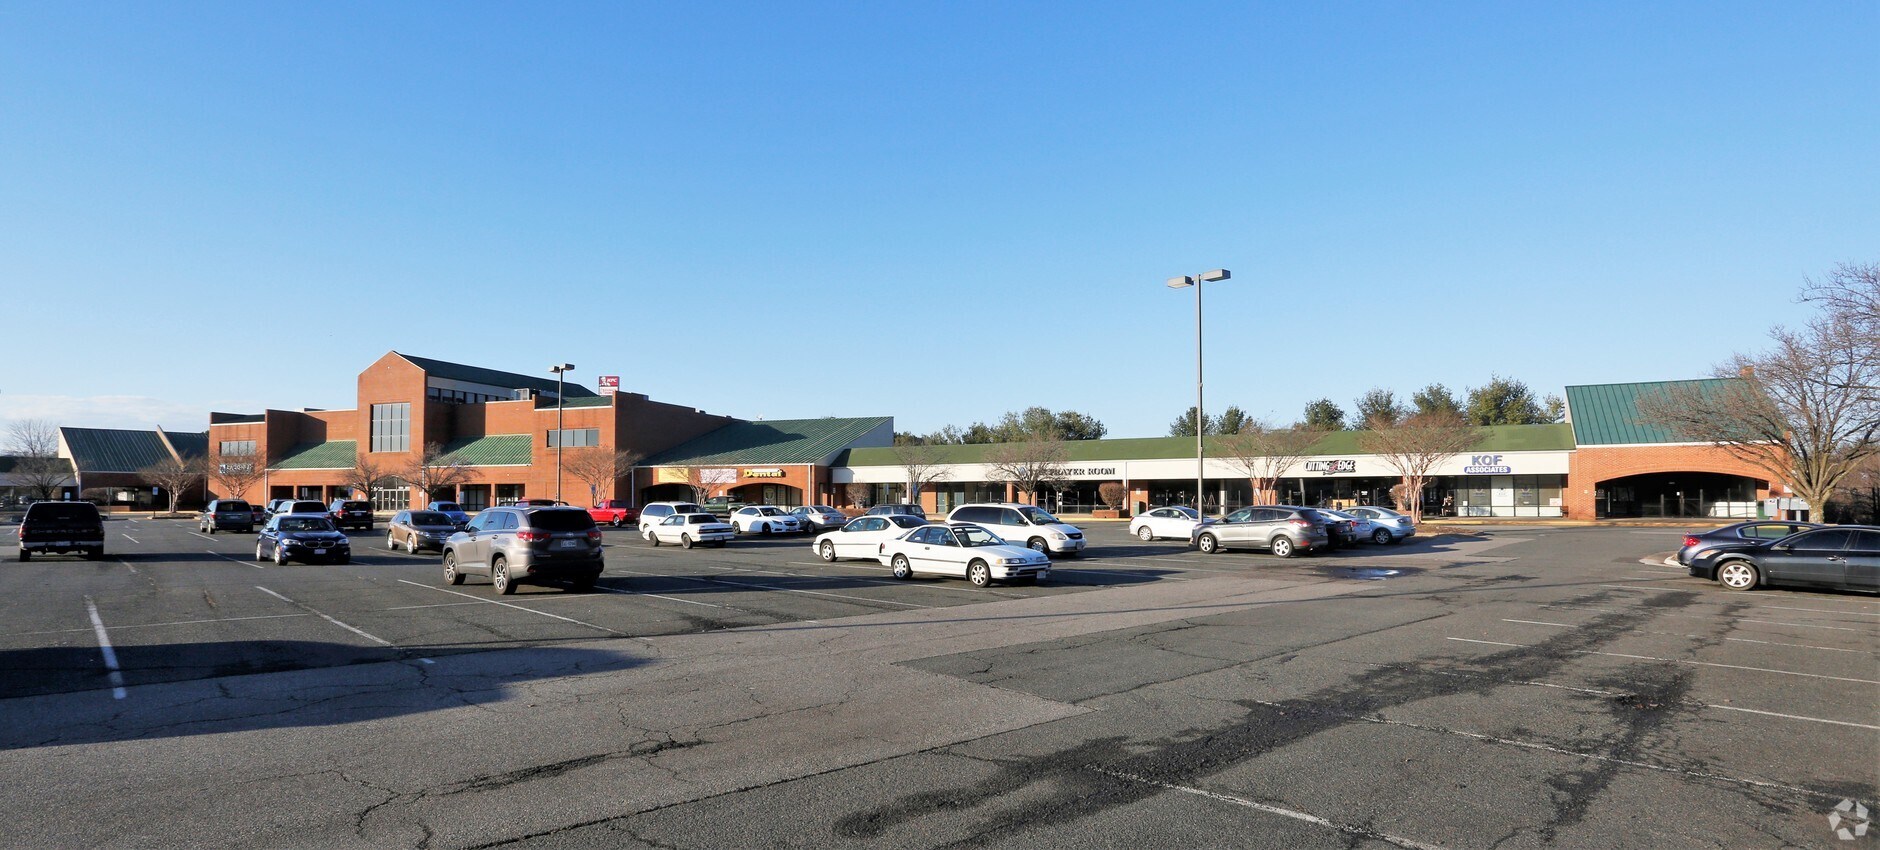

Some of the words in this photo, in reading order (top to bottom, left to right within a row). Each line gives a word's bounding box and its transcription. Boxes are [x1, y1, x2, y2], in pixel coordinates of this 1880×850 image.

[1472, 455, 1503, 466] KOF
[1304, 460, 1330, 472] CUTTING
[1337, 460, 1356, 472] EDGE
[1465, 466, 1508, 474] ASSOCIATES
[743, 469, 783, 478] Dental
[1088, 467, 1115, 475] ROOM
